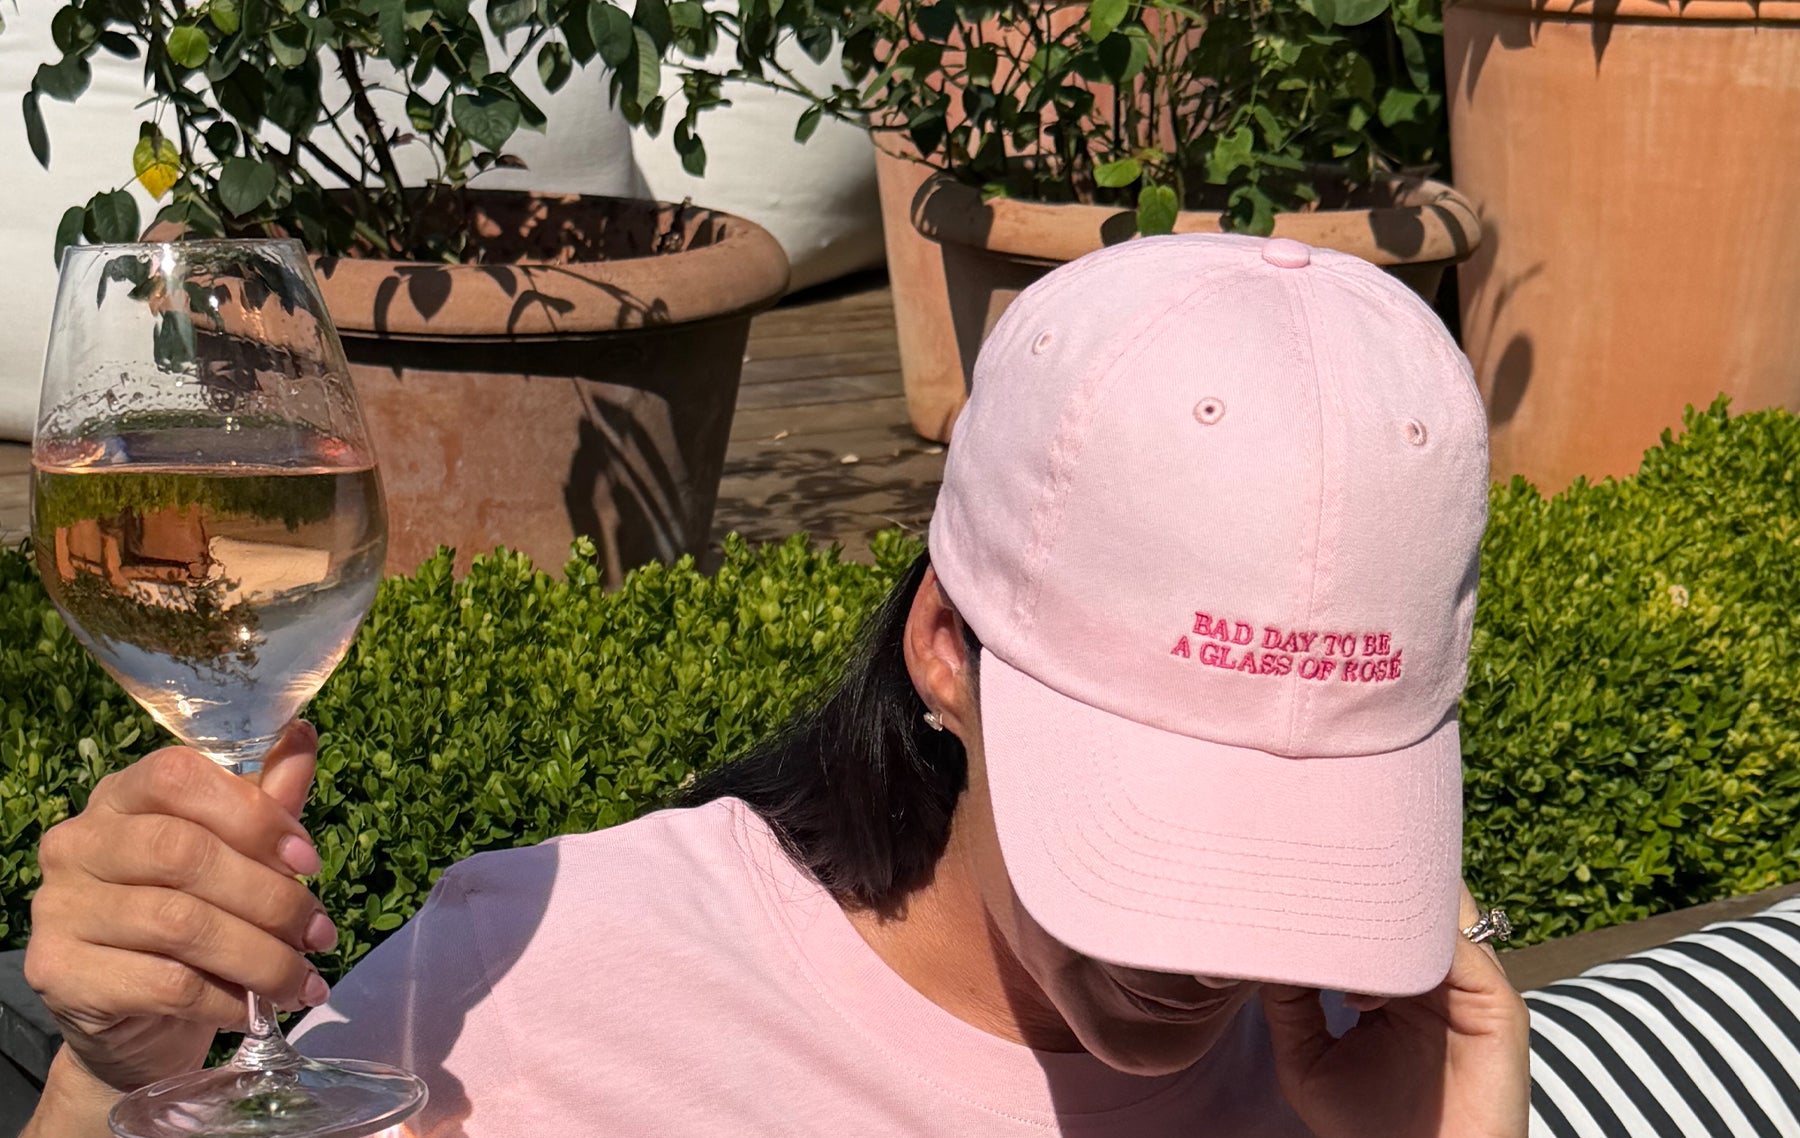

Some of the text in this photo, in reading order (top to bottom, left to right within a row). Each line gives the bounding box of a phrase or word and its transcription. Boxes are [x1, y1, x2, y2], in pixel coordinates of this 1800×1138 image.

[1170, 635, 1403, 683] A GLASS OF ROSÉ
[1192, 611, 1392, 659] BAD DAY TO BE
